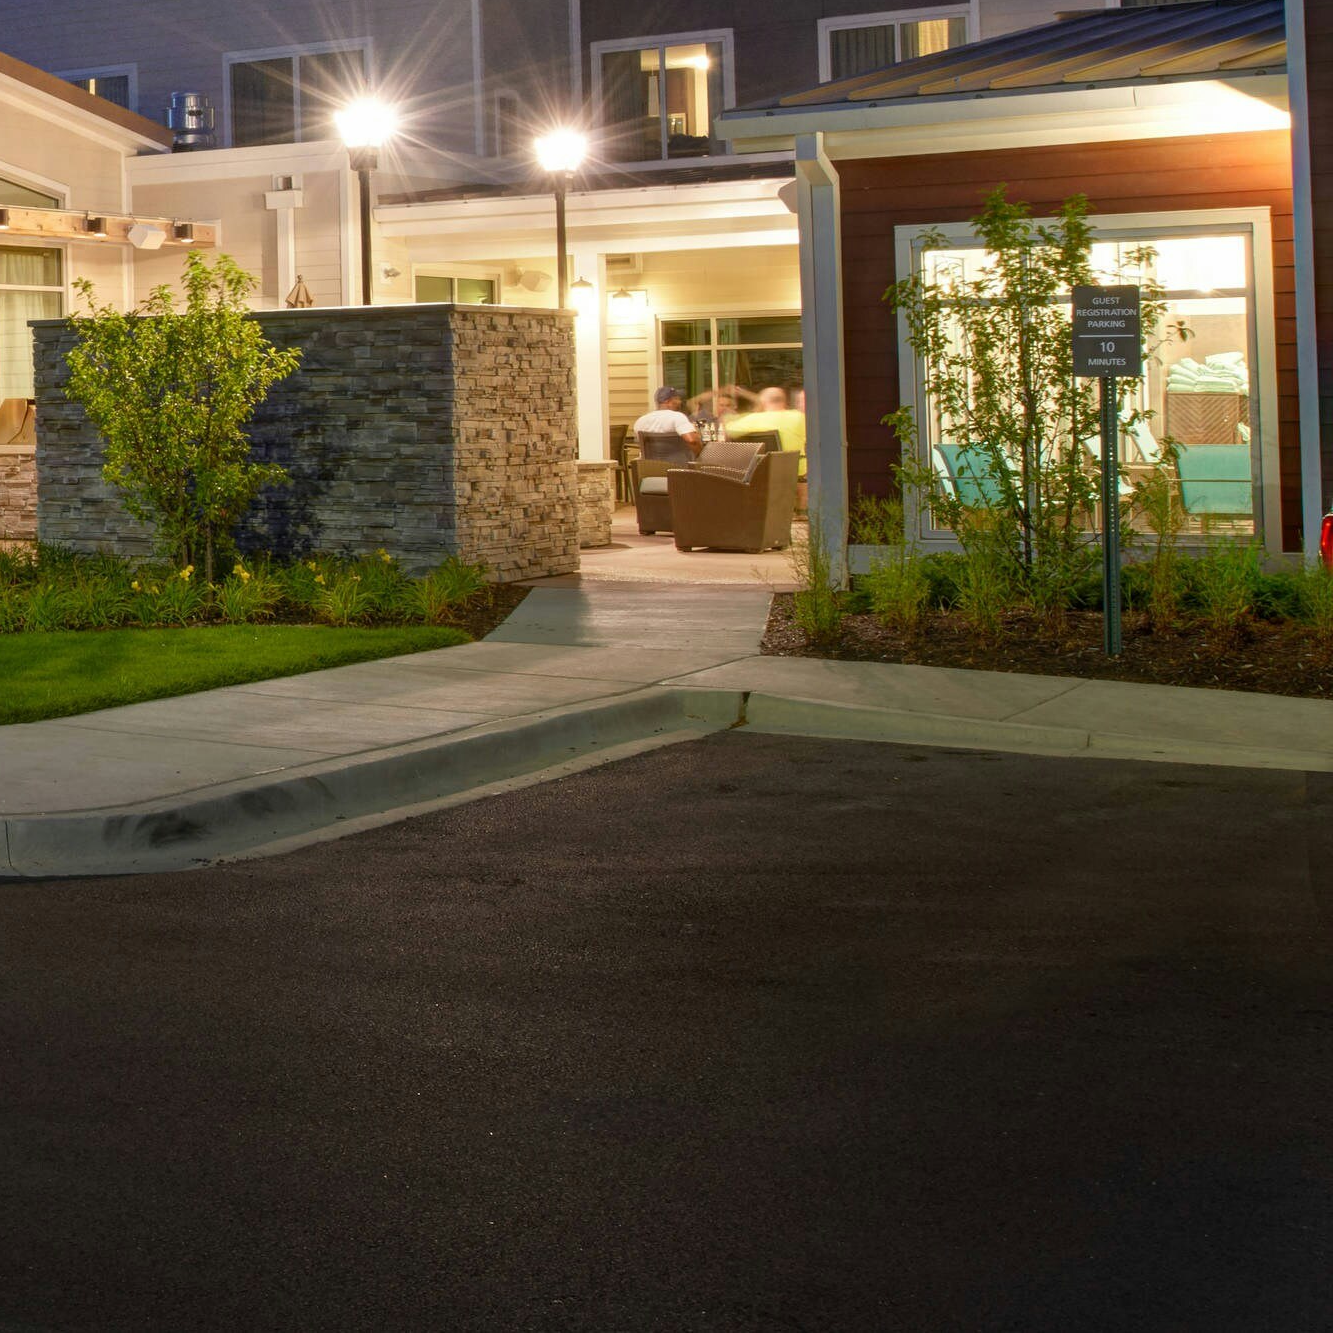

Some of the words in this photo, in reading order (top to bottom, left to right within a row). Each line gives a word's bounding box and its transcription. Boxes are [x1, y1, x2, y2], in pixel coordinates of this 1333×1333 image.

[1092, 297, 1120, 305] GUEST
[1076, 308, 1137, 317] REGISTRATION
[1087, 320, 1126, 328] PARKING
[1100, 341, 1116, 353] 10
[1087, 358, 1126, 366] MINUTES
